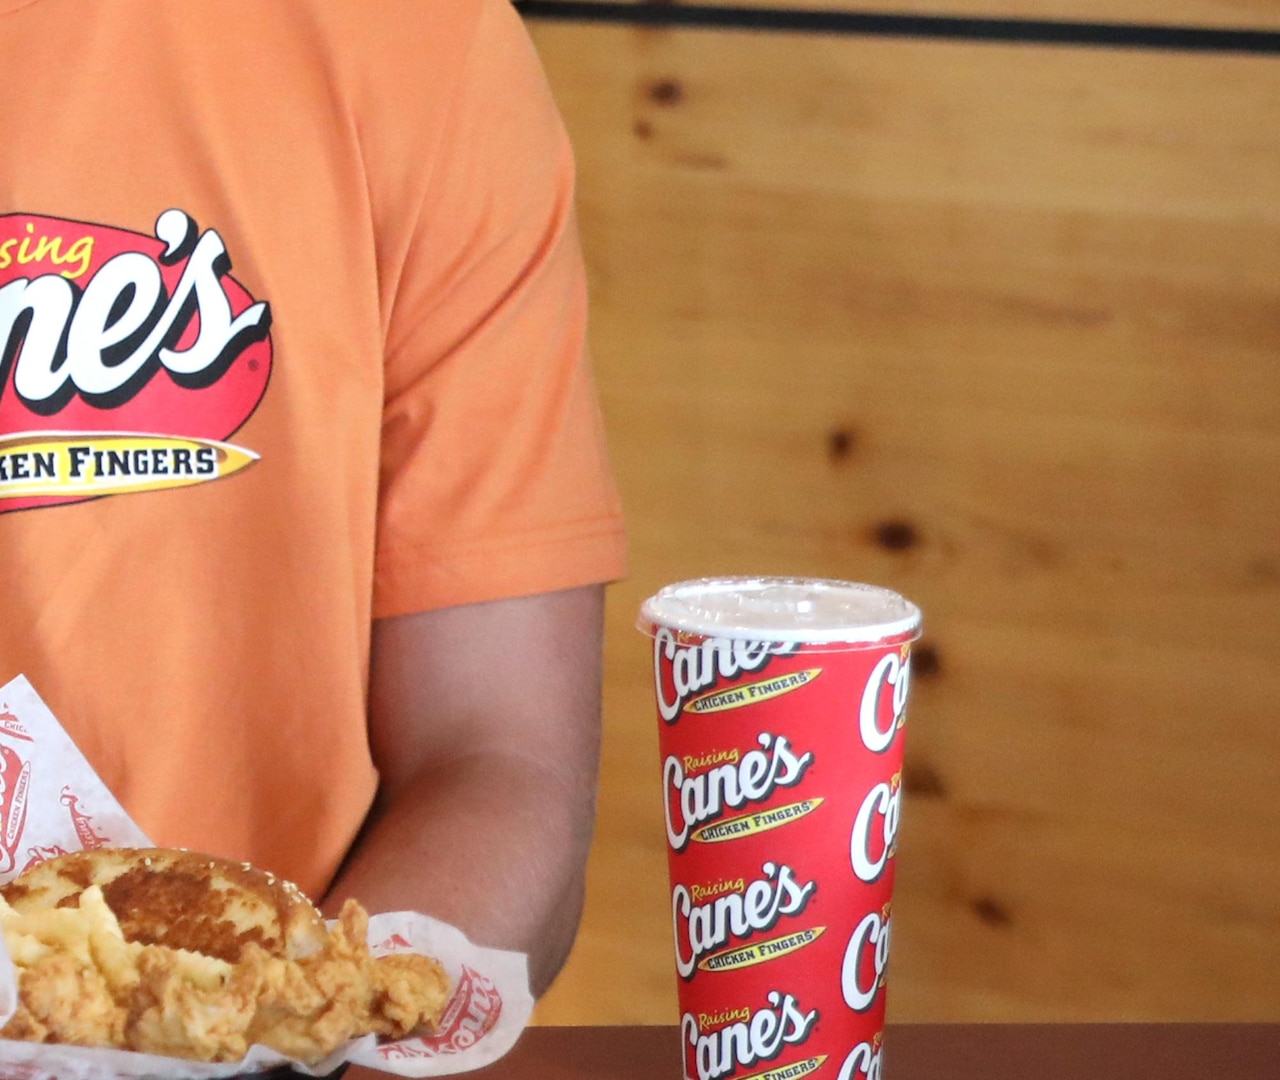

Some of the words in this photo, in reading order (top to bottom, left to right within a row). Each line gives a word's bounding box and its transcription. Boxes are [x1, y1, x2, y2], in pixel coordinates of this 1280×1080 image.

[67, 445, 216, 480] FINGERS
[693, 690, 744, 712] CHICKEN
[749, 672, 808, 697] FINGERS
[683, 748, 740, 774] Raising
[7, 805, 21, 840] CHICKEN
[15, 770, 29, 803] FINGERS
[664, 732, 812, 850] Cane's
[701, 820, 750, 841] CHICKEN
[752, 801, 811, 827] FINGERS
[691, 877, 745, 902] Raising
[673, 862, 815, 978] Cane's
[707, 949, 756, 969] CHICKEN
[759, 930, 814, 956] FINGERS
[682, 991, 816, 1080] Cane's
[698, 1007, 750, 1031] Raising
